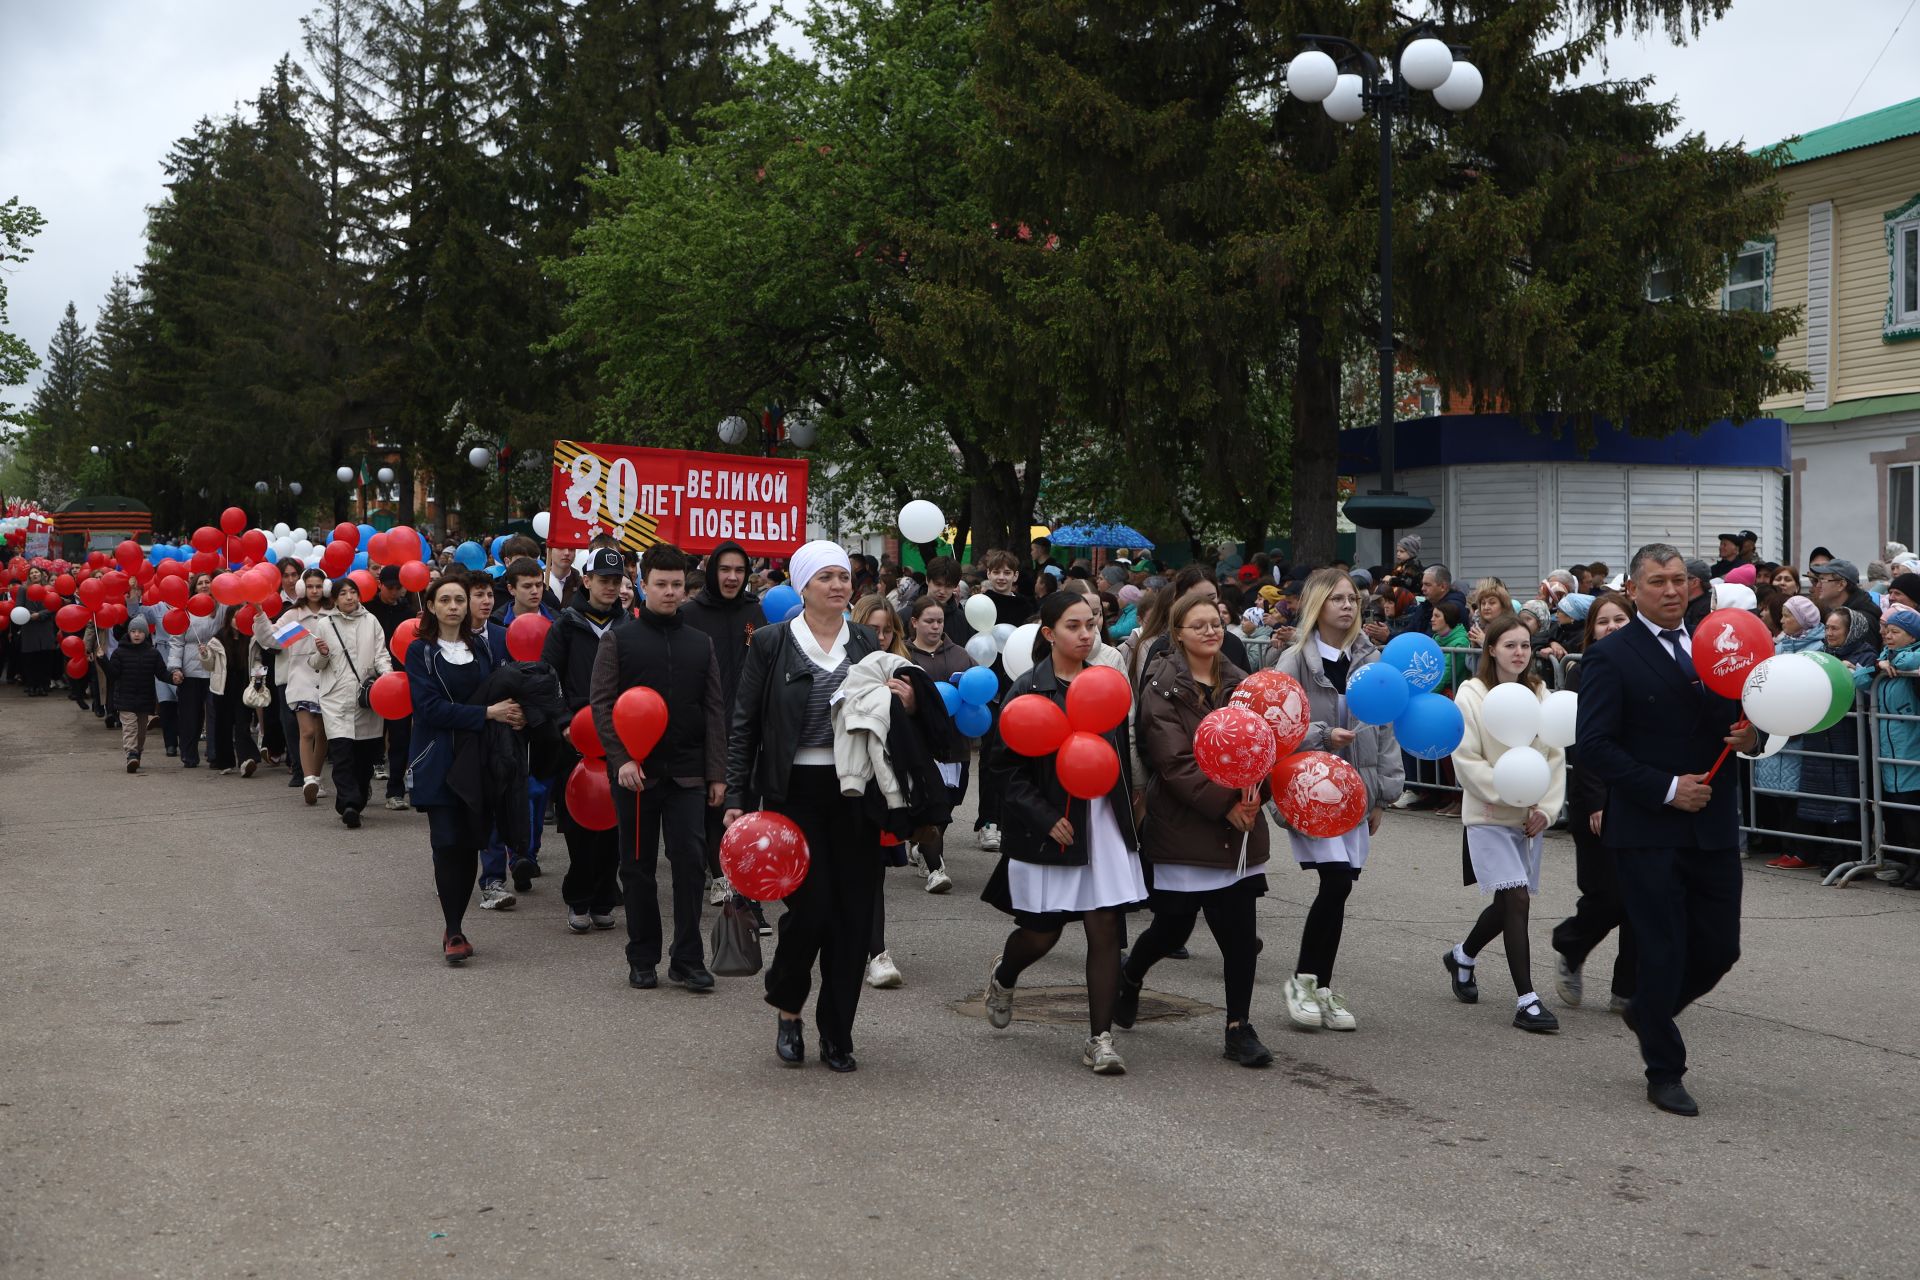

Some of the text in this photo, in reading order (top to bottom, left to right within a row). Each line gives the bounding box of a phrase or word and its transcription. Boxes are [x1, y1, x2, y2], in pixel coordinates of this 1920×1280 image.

[565, 453, 685, 523] 80 ЛЕТ
[687, 469, 788, 503] ВЕЛИКОЙ
[690, 504, 798, 542] ПОБЕДЫ!
